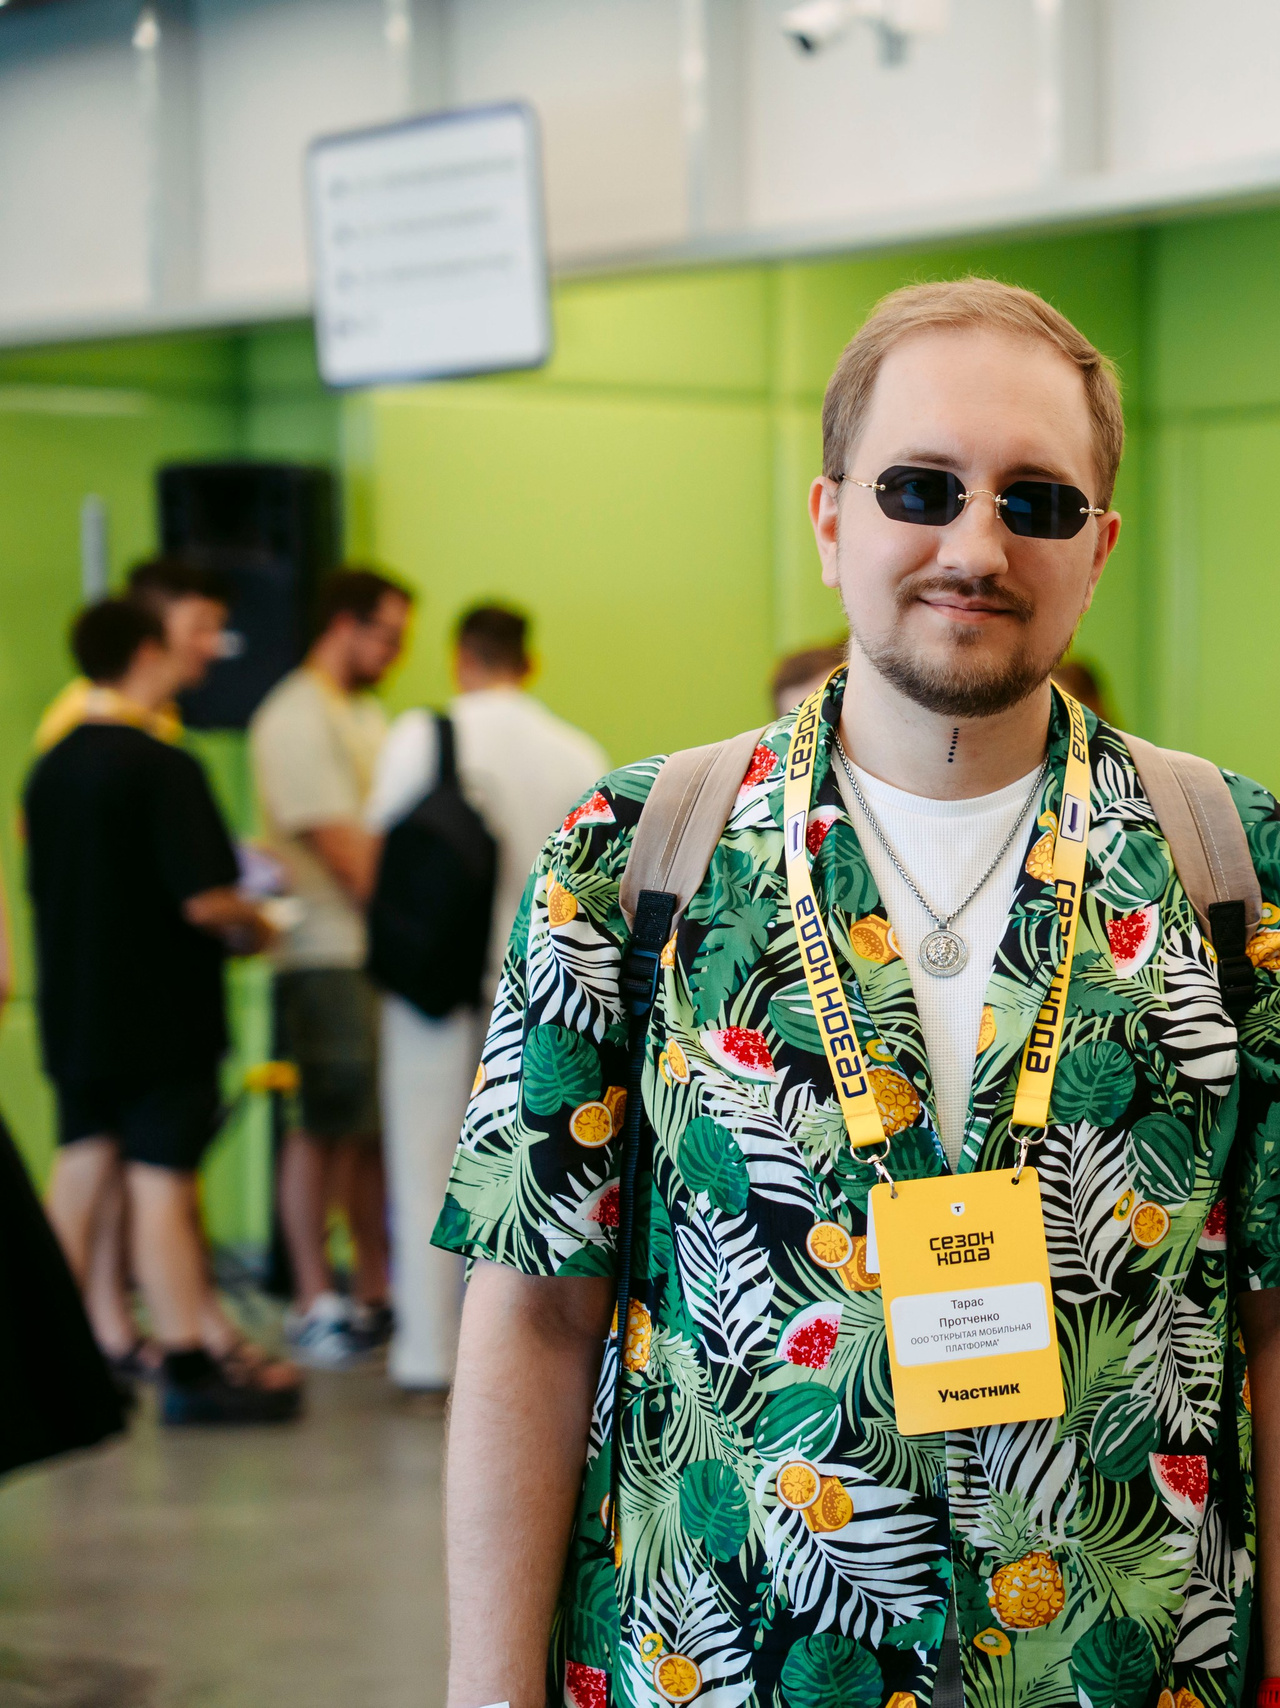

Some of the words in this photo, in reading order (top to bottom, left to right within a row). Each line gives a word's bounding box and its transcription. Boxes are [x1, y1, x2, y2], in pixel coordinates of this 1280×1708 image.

[929, 1230, 995, 1251] сезон
[937, 1247, 990, 1266] кода
[951, 1297, 984, 1310] Тарас
[939, 1311, 1000, 1328] Протченко
[911, 1334, 929, 1345] ООО
[978, 1323, 1032, 1337] МОБИЛЬНАЯ
[938, 1383, 1020, 1402] Участник
